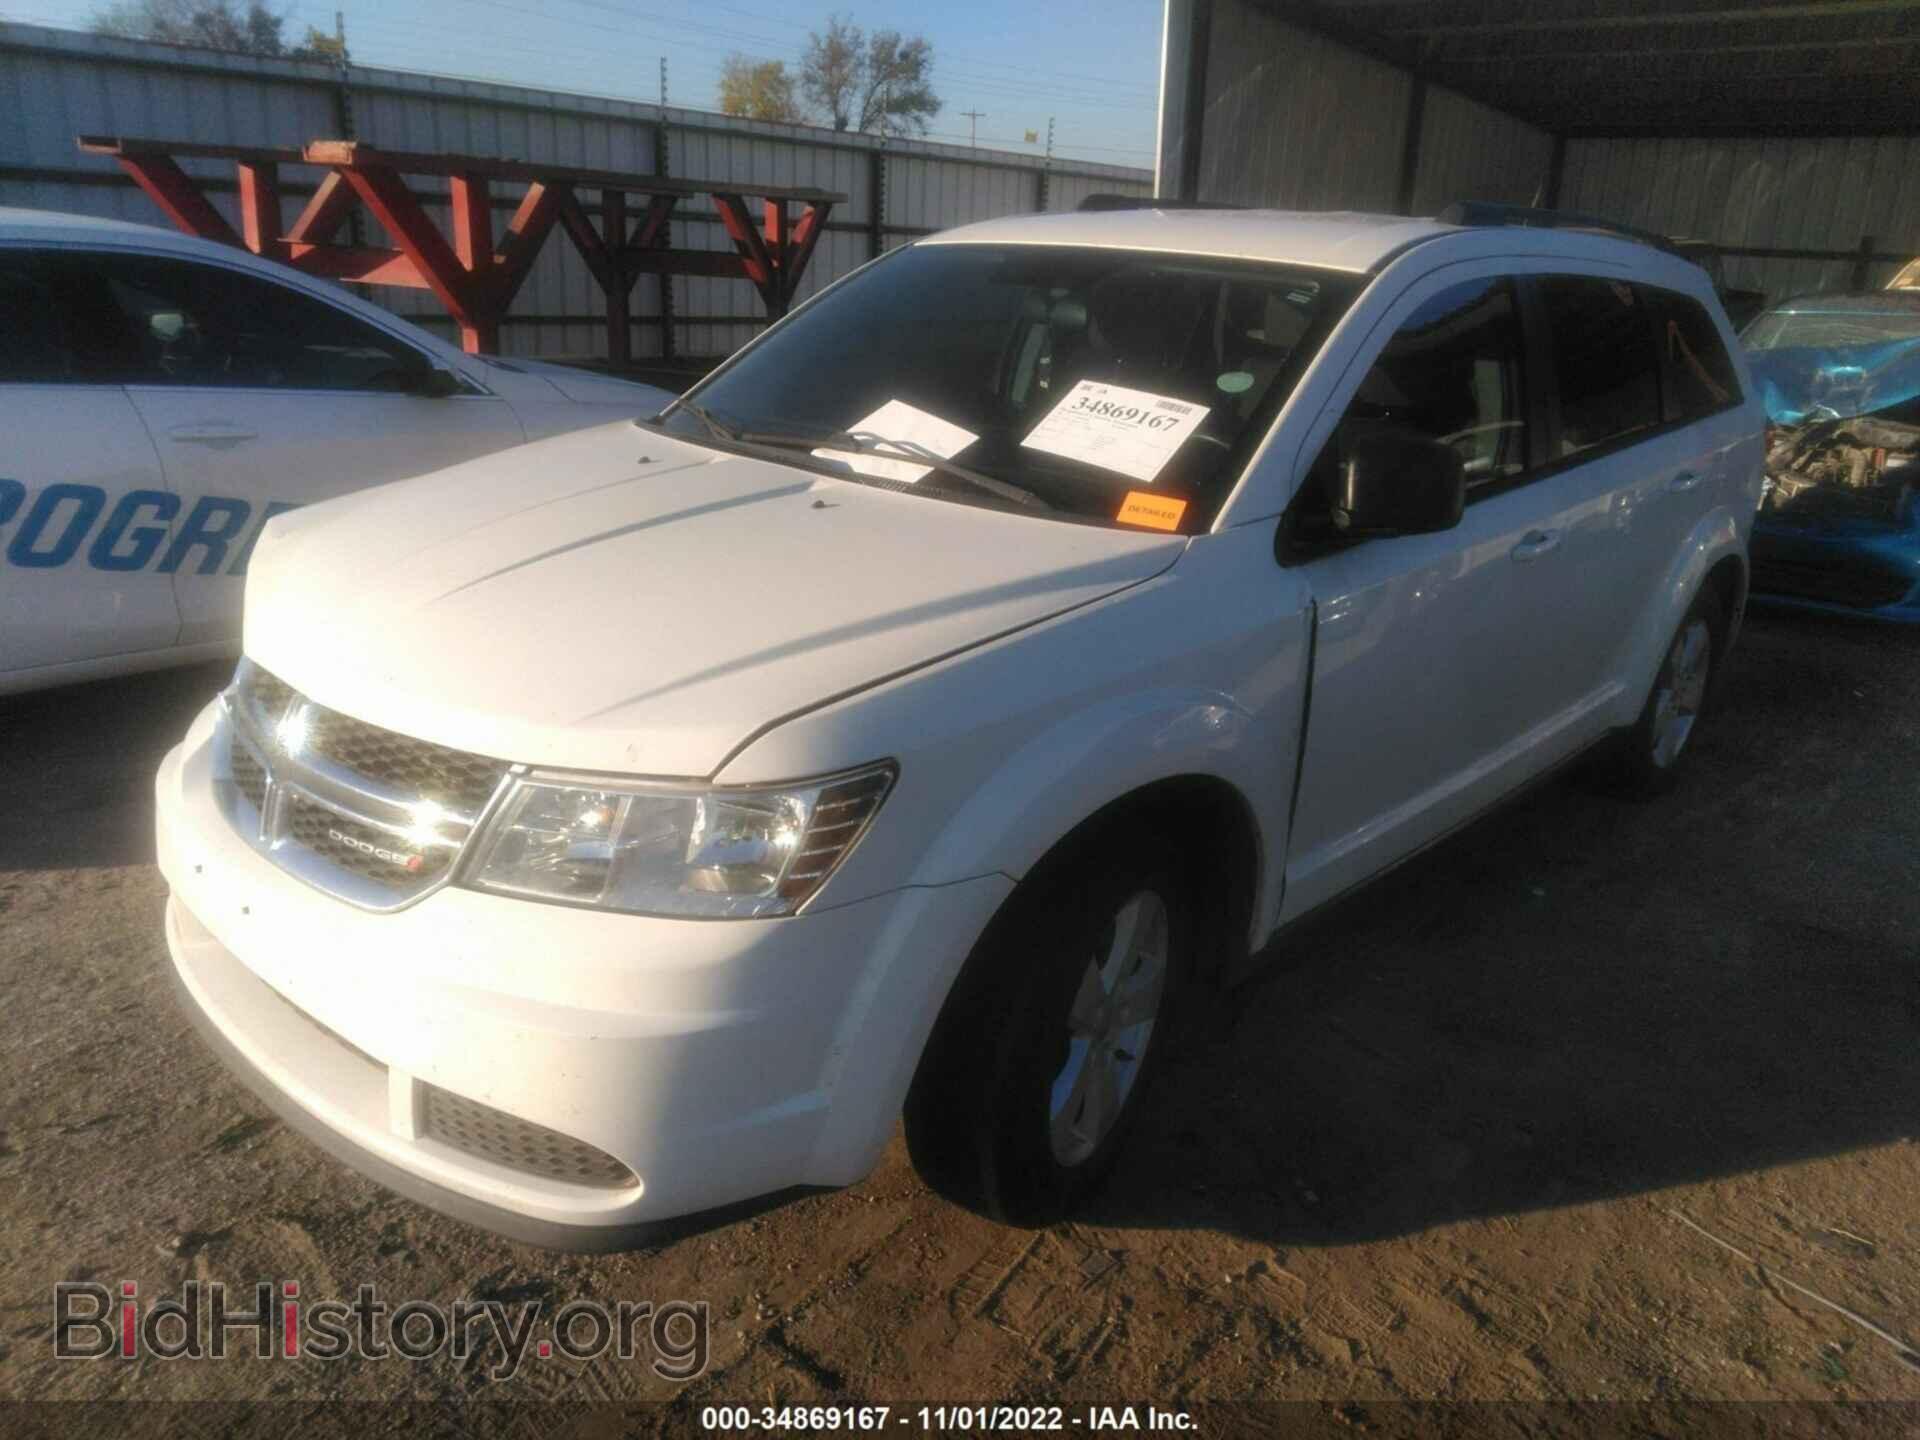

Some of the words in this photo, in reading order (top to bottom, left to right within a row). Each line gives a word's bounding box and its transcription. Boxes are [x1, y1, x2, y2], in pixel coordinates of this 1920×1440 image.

[1071, 397, 1179, 432] 34869167
[0, 479, 309, 575] OGR
[329, 828, 407, 867] DODGE
